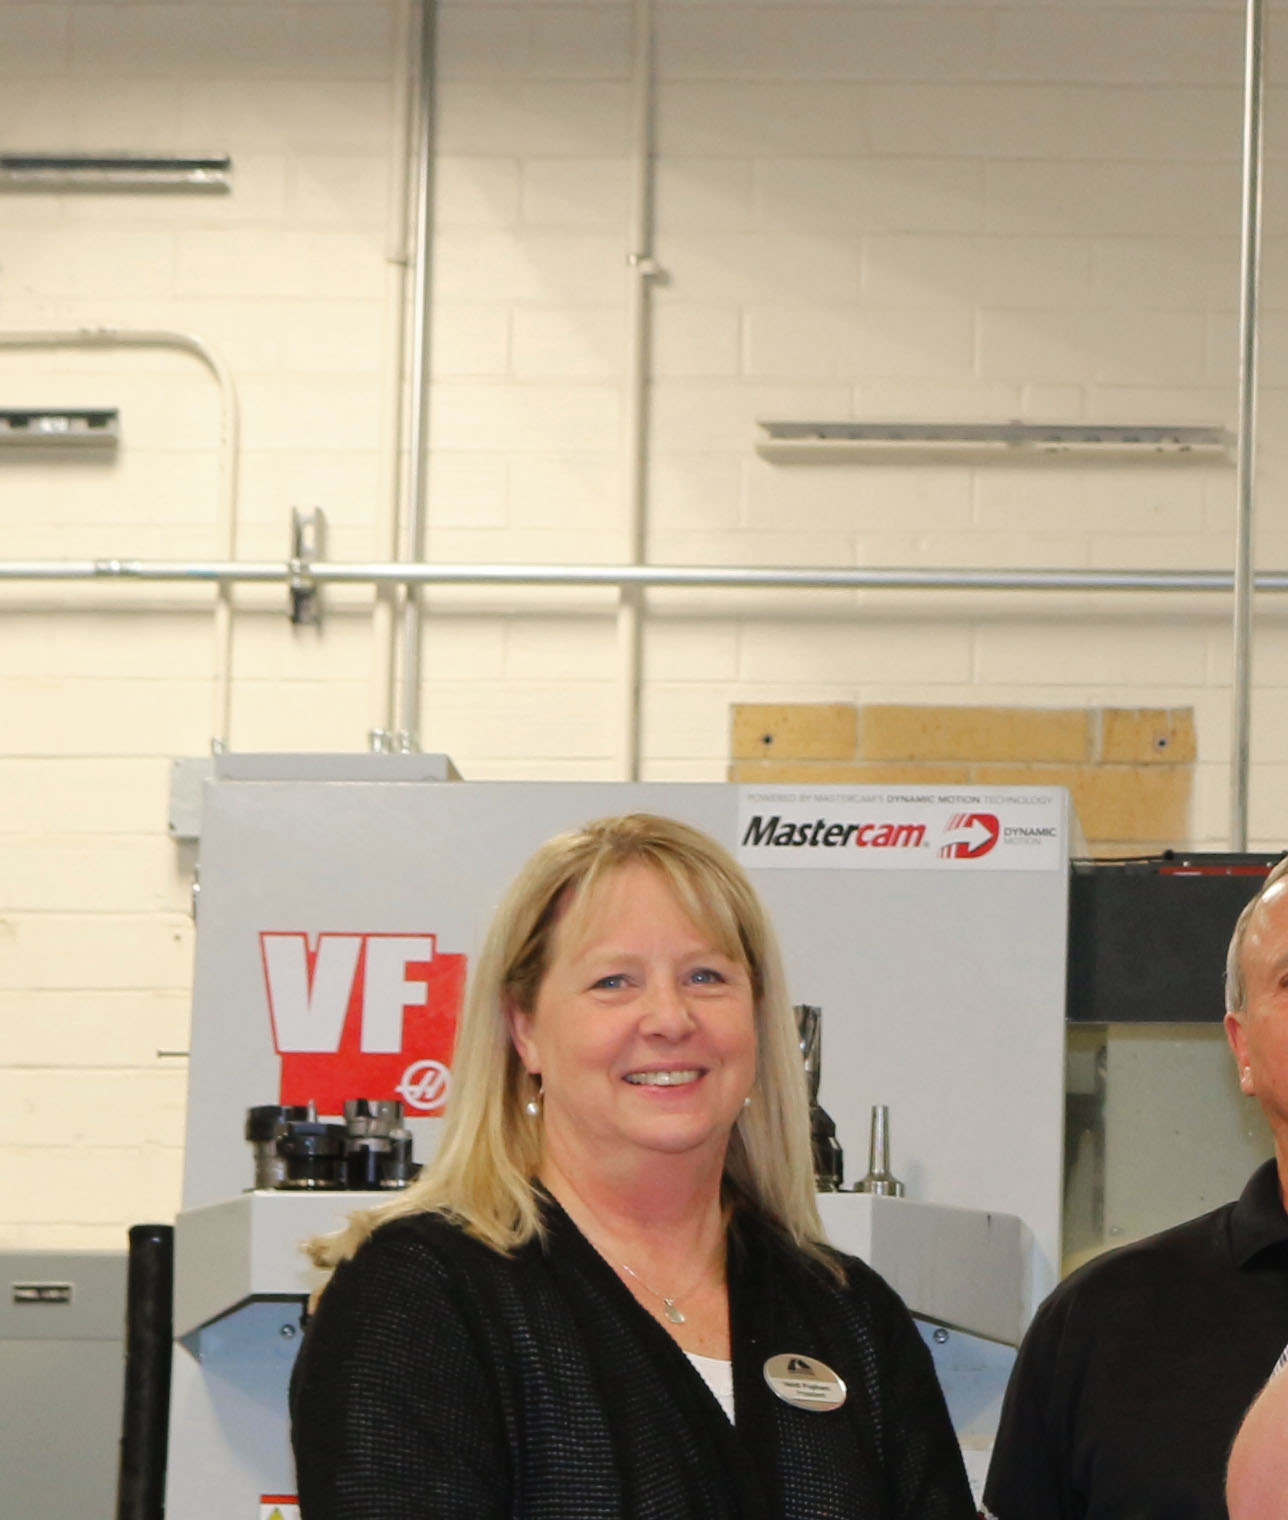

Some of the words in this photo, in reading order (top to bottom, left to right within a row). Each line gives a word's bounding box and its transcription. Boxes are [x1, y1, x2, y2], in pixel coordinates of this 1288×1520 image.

[887, 795, 936, 804] DYNAMIC
[938, 795, 981, 804] MOTION
[742, 816, 926, 848] Mastercam
[1003, 827, 1057, 838] DYNAMIC
[259, 932, 435, 1054] VF
